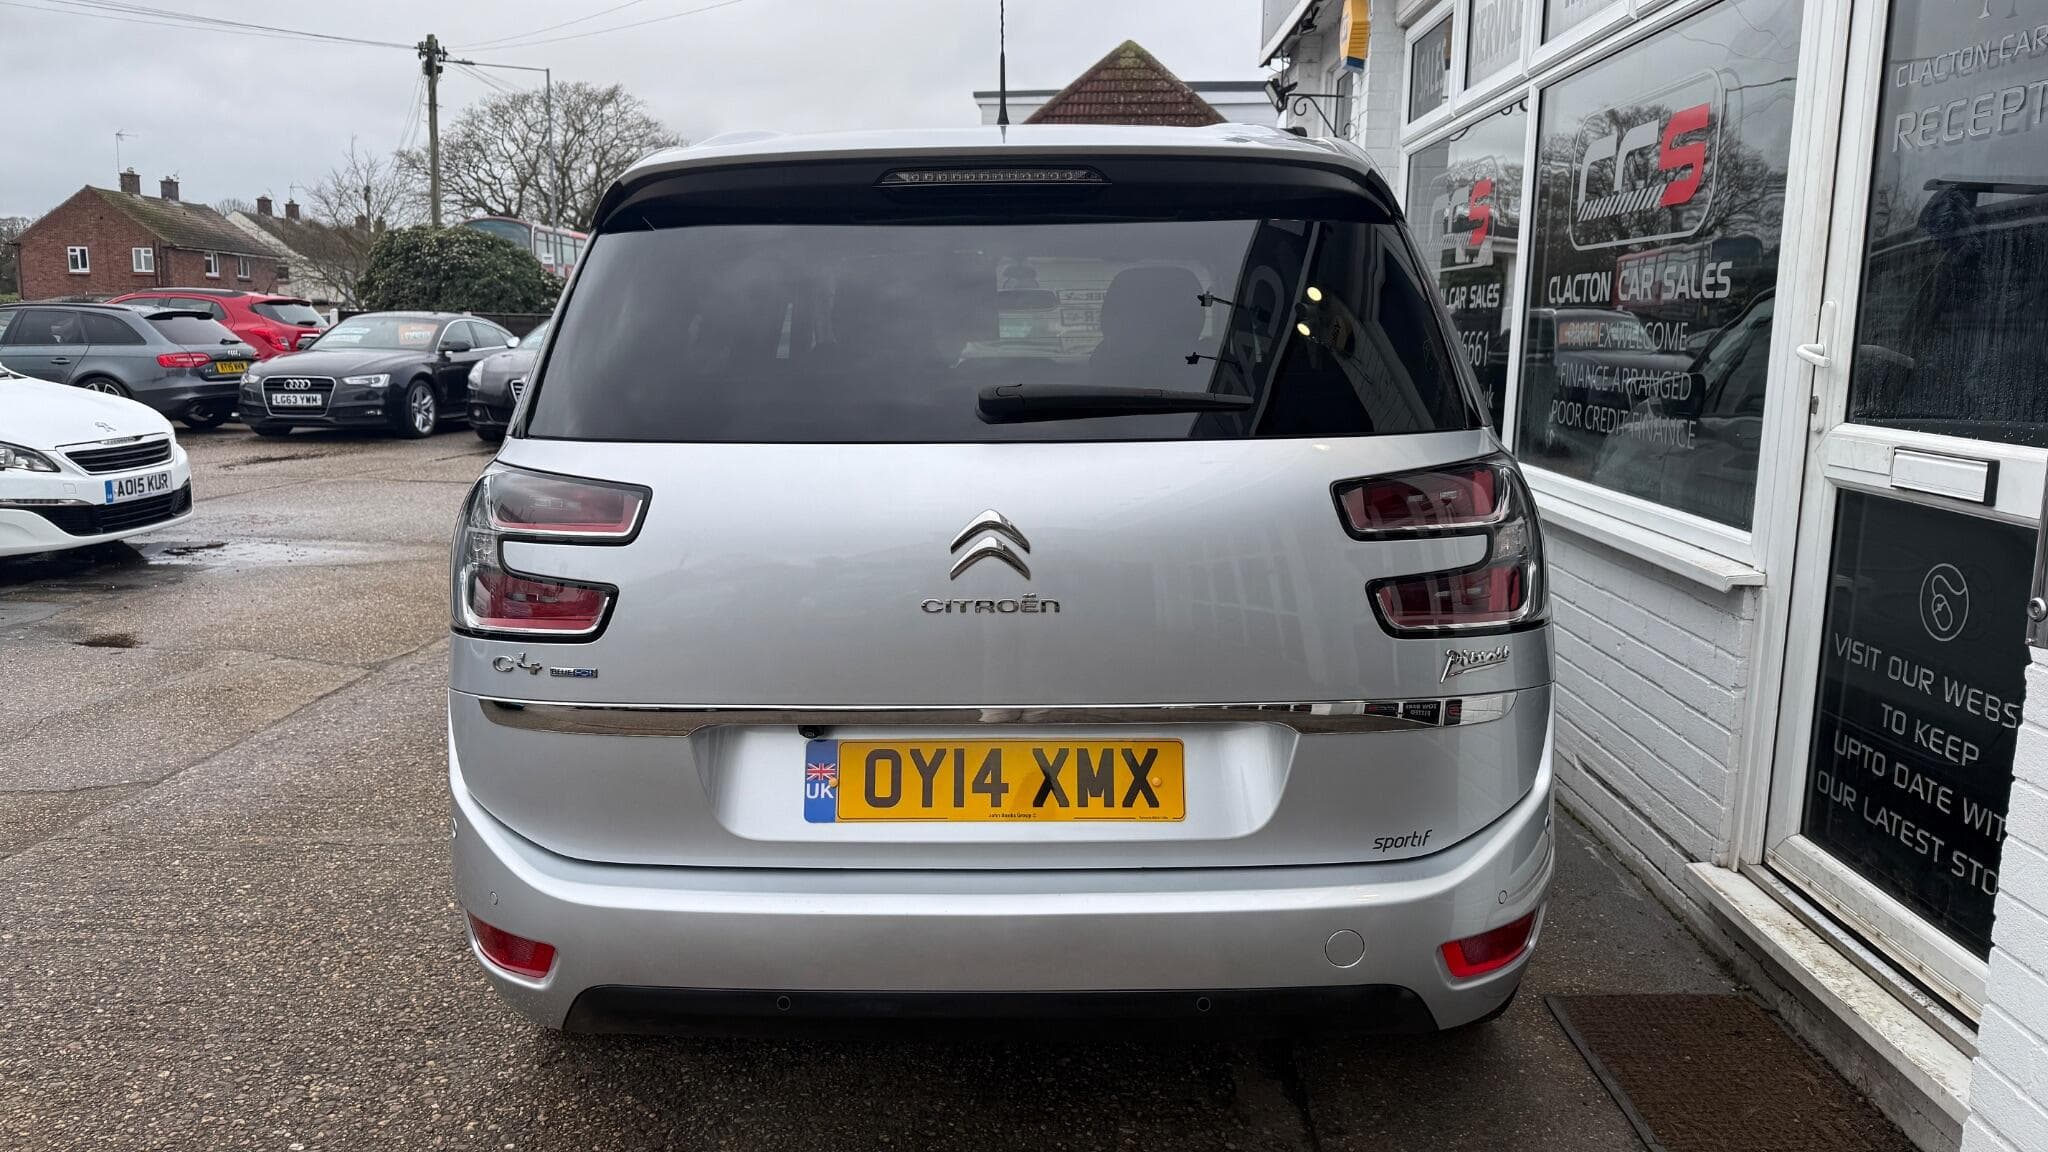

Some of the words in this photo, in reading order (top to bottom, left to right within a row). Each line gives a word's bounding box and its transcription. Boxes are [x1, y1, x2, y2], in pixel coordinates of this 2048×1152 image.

[1896, 40, 1991, 88] CLACTON
[1999, 24, 2048, 59] CAR
[1448, 286, 1468, 309] CAR
[1469, 283, 1501, 309] SALES
[1548, 271, 1612, 304] CLACTON
[1617, 268, 1654, 301] CAR
[1661, 261, 1733, 300] SALES
[1598, 322, 1613, 348] EX
[1615, 321, 1689, 352] WELCOME
[275, 395, 297, 404] LG63
[1560, 362, 1610, 391] FINANCE
[1611, 367, 1692, 401] ARRANGED
[1551, 399, 1582, 429] POOR
[1584, 405, 1628, 436] CREDIT
[1630, 411, 1697, 450] FINANCE
[117, 478, 145, 497] AO15
[147, 473, 169, 492] KUR
[493, 653, 543, 675] C4
[1834, 632, 1882, 671] VISIT
[1887, 655, 1934, 696] OUR
[1944, 675, 2021, 729] WEBS
[1881, 702, 1907, 736] TO
[1914, 719, 1980, 767] KEEP
[806, 782, 835, 799] UK
[864, 747, 1009, 808] OY14
[1031, 747, 1160, 808] XMX
[1834, 728, 1886, 777] UPTO
[1893, 761, 1953, 814] DATE
[1372, 828, 1433, 853] sportif
[1817, 769, 1857, 812] OUR
[1863, 795, 1945, 864] LATEST
[1951, 849, 1999, 896] STO
